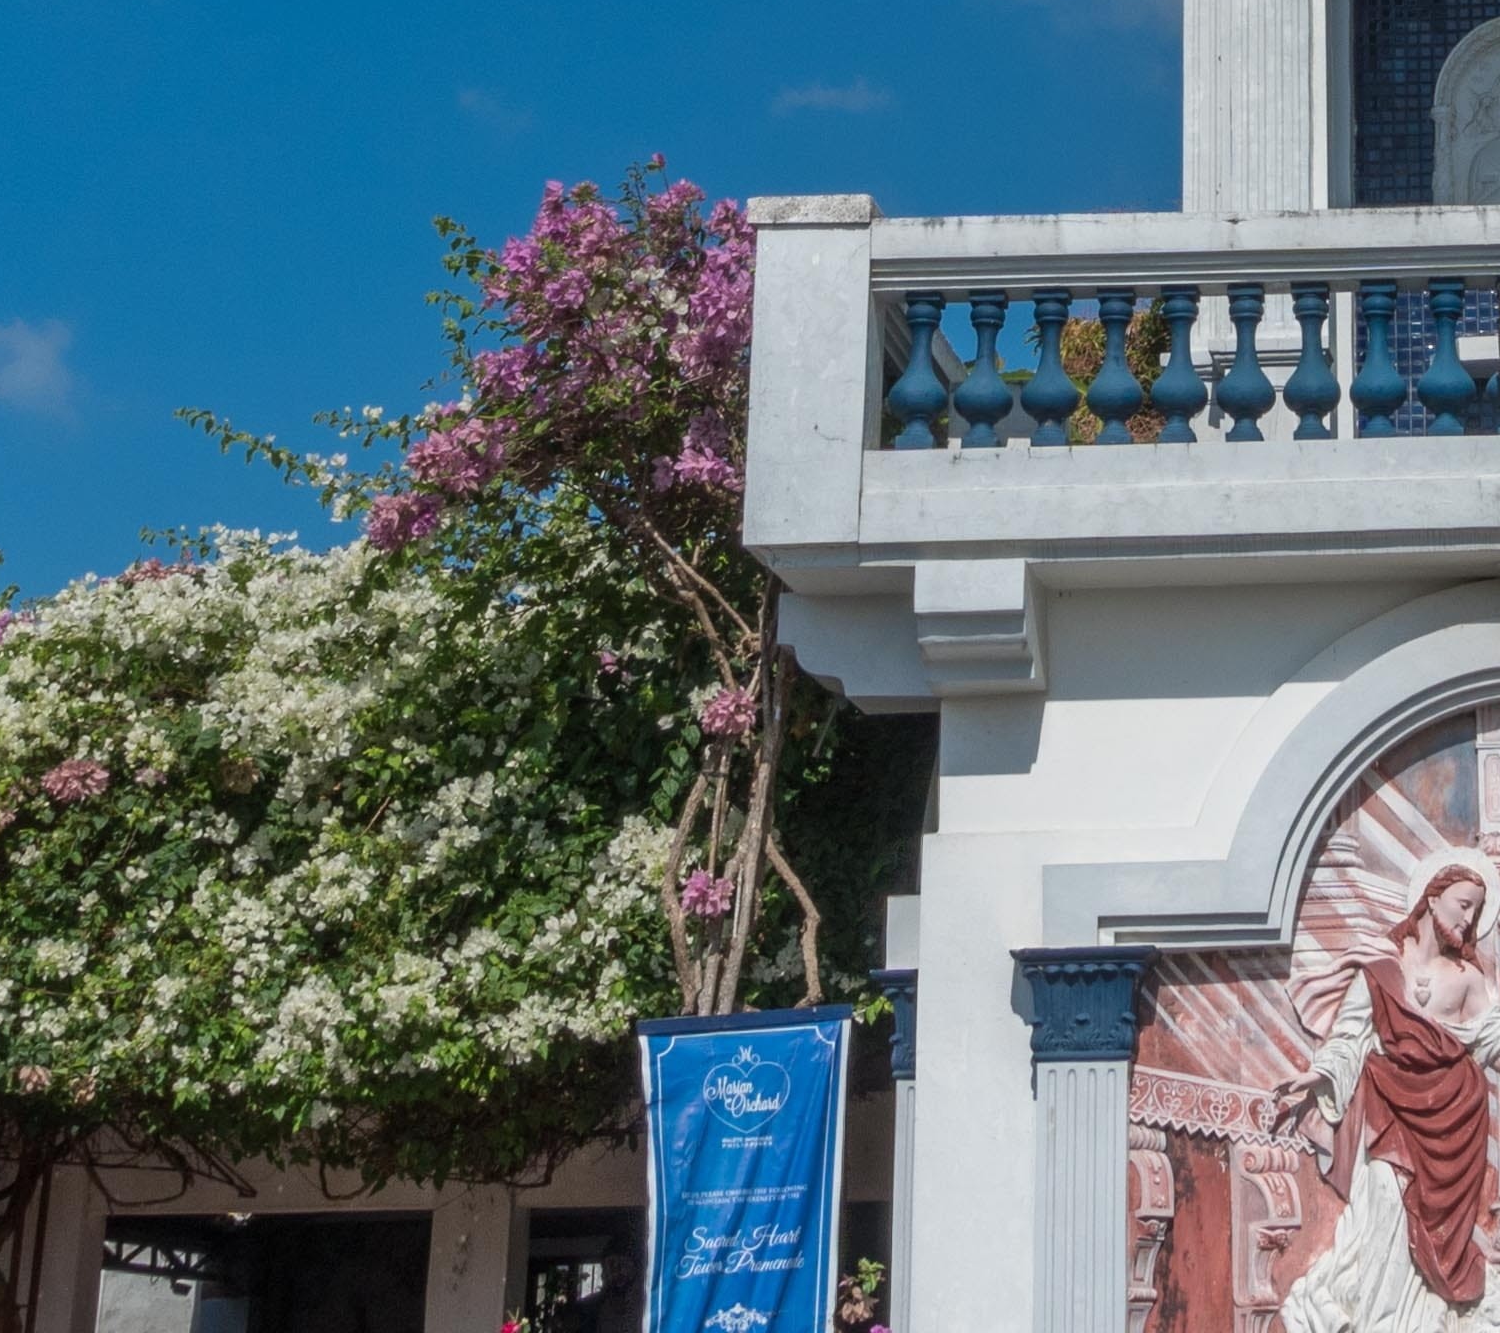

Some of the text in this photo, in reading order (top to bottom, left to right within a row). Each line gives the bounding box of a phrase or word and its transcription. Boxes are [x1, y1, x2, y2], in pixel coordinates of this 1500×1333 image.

[706, 1075, 754, 1100] Marian
[725, 1093, 780, 1117] Orchard
[685, 1223, 802, 1252] Sacred Heart
[675, 1250, 805, 1279] Tower Promenade
